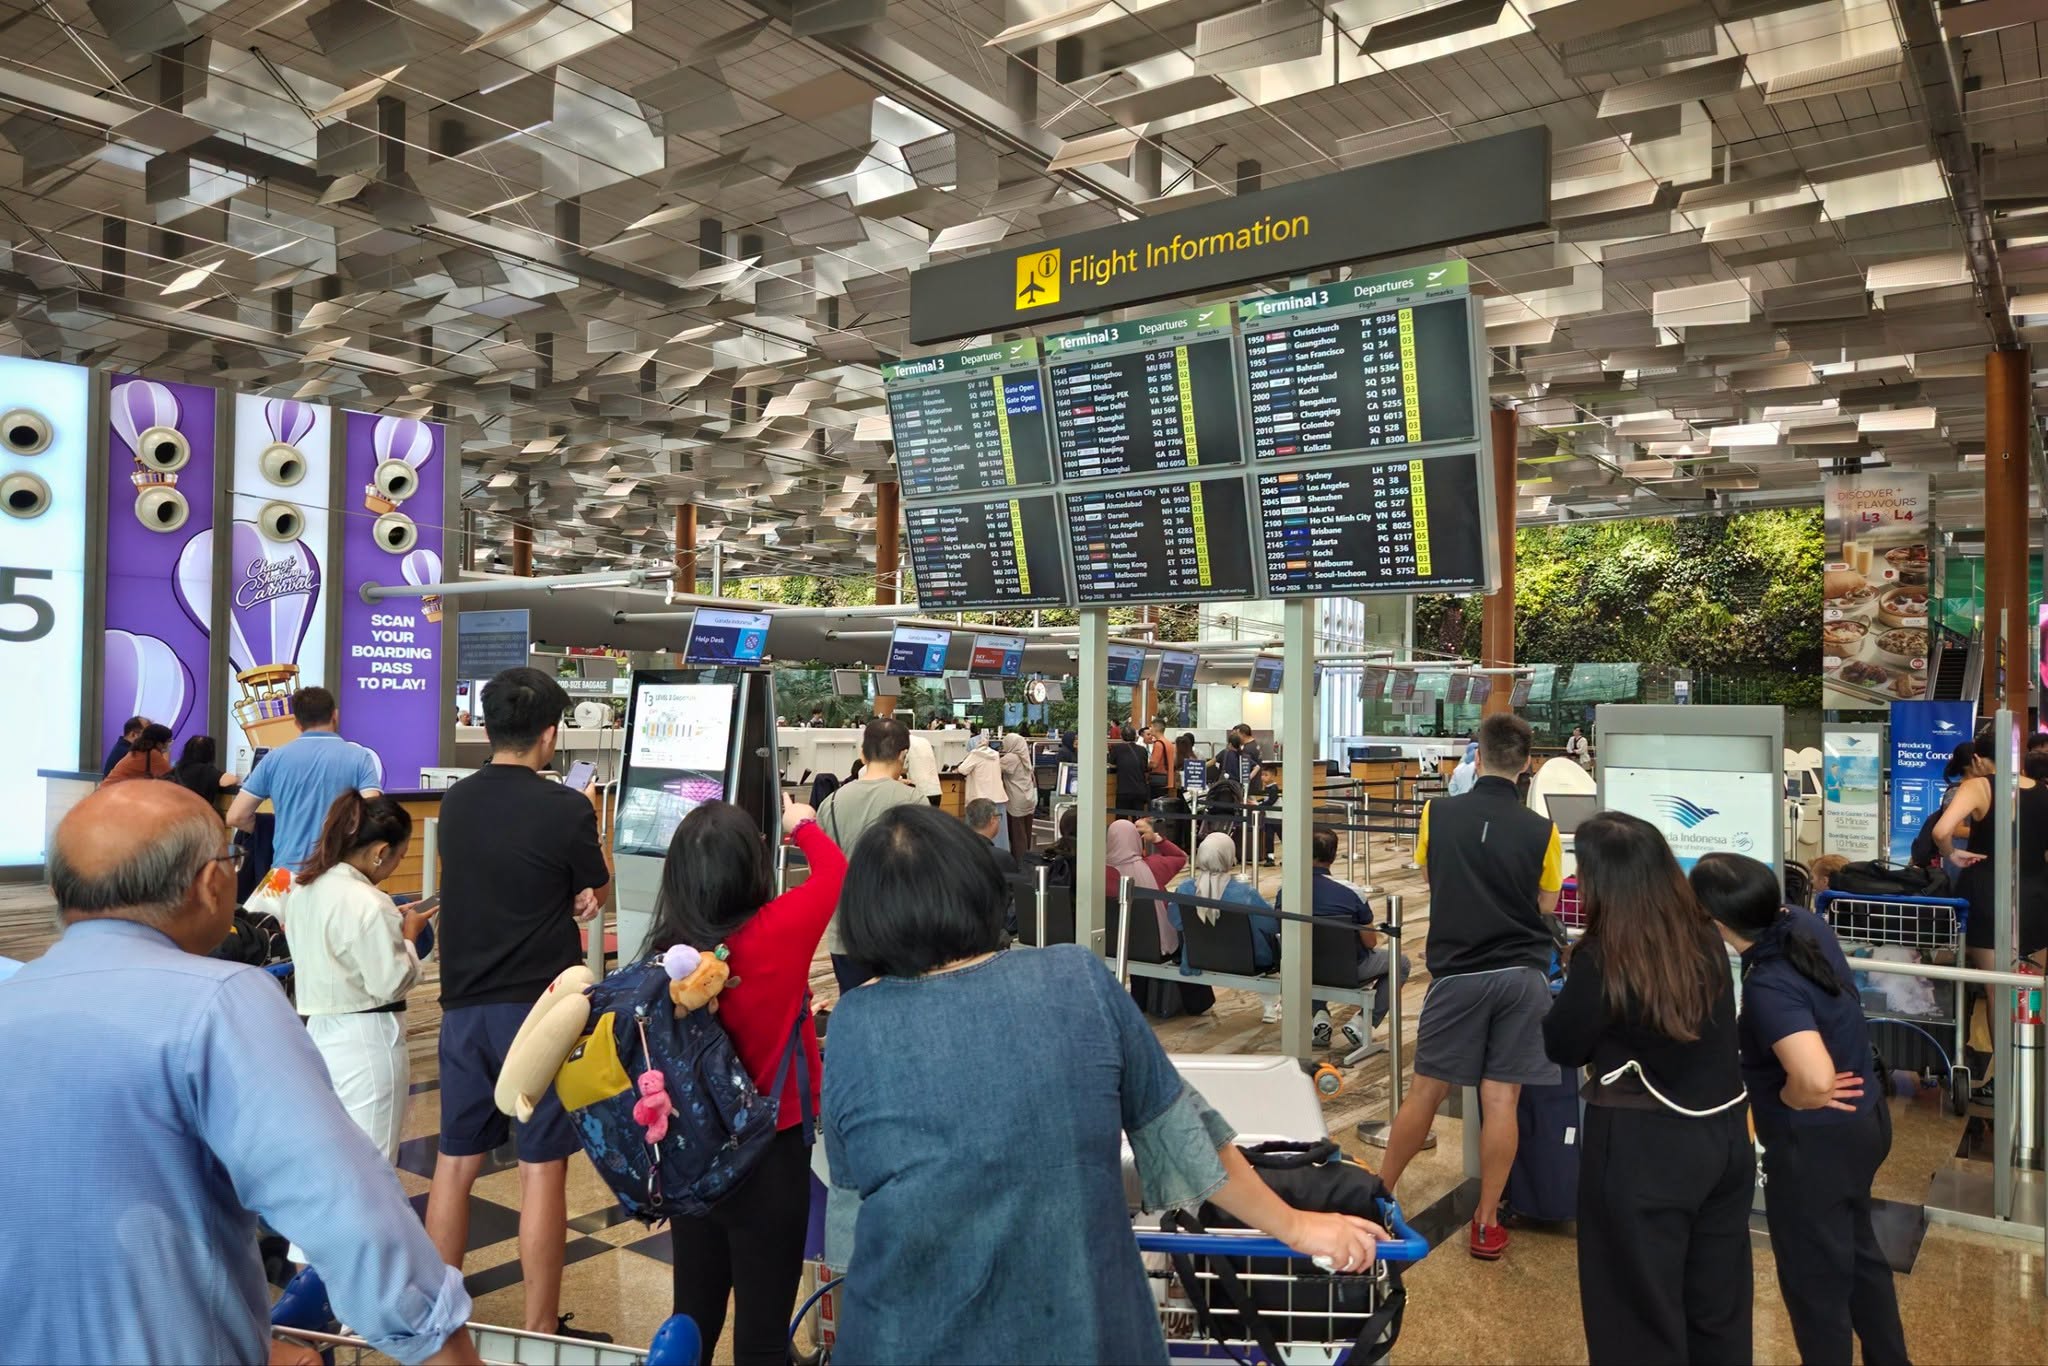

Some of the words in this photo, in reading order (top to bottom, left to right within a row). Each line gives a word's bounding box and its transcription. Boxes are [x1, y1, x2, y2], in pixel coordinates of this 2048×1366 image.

[1070, 250, 1138, 286] Flight
[1146, 214, 1310, 267] Information
[1256, 292, 1316, 315] Terminal
[1320, 291, 1329, 304] 3
[1354, 278, 1414, 297] Departures
[1359, 300, 1376, 309] Flight
[1426, 289, 1453, 298] Remarks
[1058, 329, 1109, 349] Terminal
[1112, 328, 1119, 340] 3
[1139, 318, 1188, 335] Departures
[1248, 335, 1265, 344] 1950
[1293, 323, 1339, 337] Christchurch
[1361, 318, 1371, 326] TK
[1376, 314, 1396, 324] 9336
[1400, 312, 1410, 320] 03
[1248, 347, 1266, 356] 1950
[1294, 337, 1336, 349] Guangzhou
[1362, 330, 1371, 338] ET
[1377, 326, 1397, 336] 1346
[1401, 324, 1411, 332] 03
[1250, 358, 1267, 367] 1955
[1310, 348, 1345, 358] Francisco
[1362, 342, 1374, 351] SQ
[1378, 340, 1388, 348] 34
[1402, 336, 1412, 344] 03
[894, 360, 936, 377] Terminal
[938, 359, 944, 370] 3
[961, 351, 1002, 365] Departures
[1091, 371, 1123, 381] Hangzhou
[1159, 362, 1171, 370] 898
[1250, 370, 1268, 379] 2000
[1296, 362, 1324, 372] Bahrain
[1363, 354, 1374, 362] GF
[1379, 351, 1394, 360] 166
[1403, 349, 1413, 357] 05
[1093, 383, 1112, 391] Dhaka
[1160, 373, 1172, 381] 585
[1252, 381, 1269, 390] 2000
[1297, 371, 1337, 385] Hyderabad
[1364, 366, 1378, 374] NH
[1380, 363, 1400, 373] 5364
[1094, 391, 1129, 402] Beijing-PEK
[1161, 384, 1174, 392] 806
[1253, 393, 1270, 401] 2000
[1298, 386, 1319, 395] Kochi
[1365, 378, 1377, 386] SQ
[1381, 376, 1396, 385] 534
[1405, 373, 1414, 381] 03
[1260, 476, 1277, 484] 2045
[1305, 472, 1332, 482] Sydney
[1388, 464, 1407, 473] 9780
[1261, 487, 1279, 495] 2045
[1320, 481, 1350, 491] Angeles
[1373, 478, 1384, 486] SQ
[1838, 488, 1893, 500] DISCOVER
[1107, 500, 1142, 509] Ahmedabad
[1262, 498, 1280, 506] 2045
[1307, 493, 1343, 502] Shenzhen
[1390, 487, 1409, 496] 3565
[1857, 497, 1917, 509] FLAVOURS
[1862, 512, 1880, 523] L3
[1894, 509, 1913, 520] L4
[1311, 527, 1342, 535] Brisbane
[1392, 521, 1412, 530] 8025
[246, 555, 297, 578] Changi
[257, 568, 302, 589] Shopping
[236, 570, 320, 607] Carnival
[0, 566, 55, 642] 5
[371, 614, 414, 627] SCAN
[371, 630, 414, 643] YOUR
[352, 645, 432, 660] BOARDING
[372, 662, 413, 674] PASS
[357, 677, 380, 689] TO
[382, 678, 426, 690] PLAY!
[582, 681, 607, 689] BAGGAGE
[1898, 750, 1923, 759] Piece
[1926, 751, 1954, 760] Conce
[1898, 760, 1927, 768] Baggage
[952, 784, 956, 792] 2
[1681, 832, 1727, 844] Indonesia
